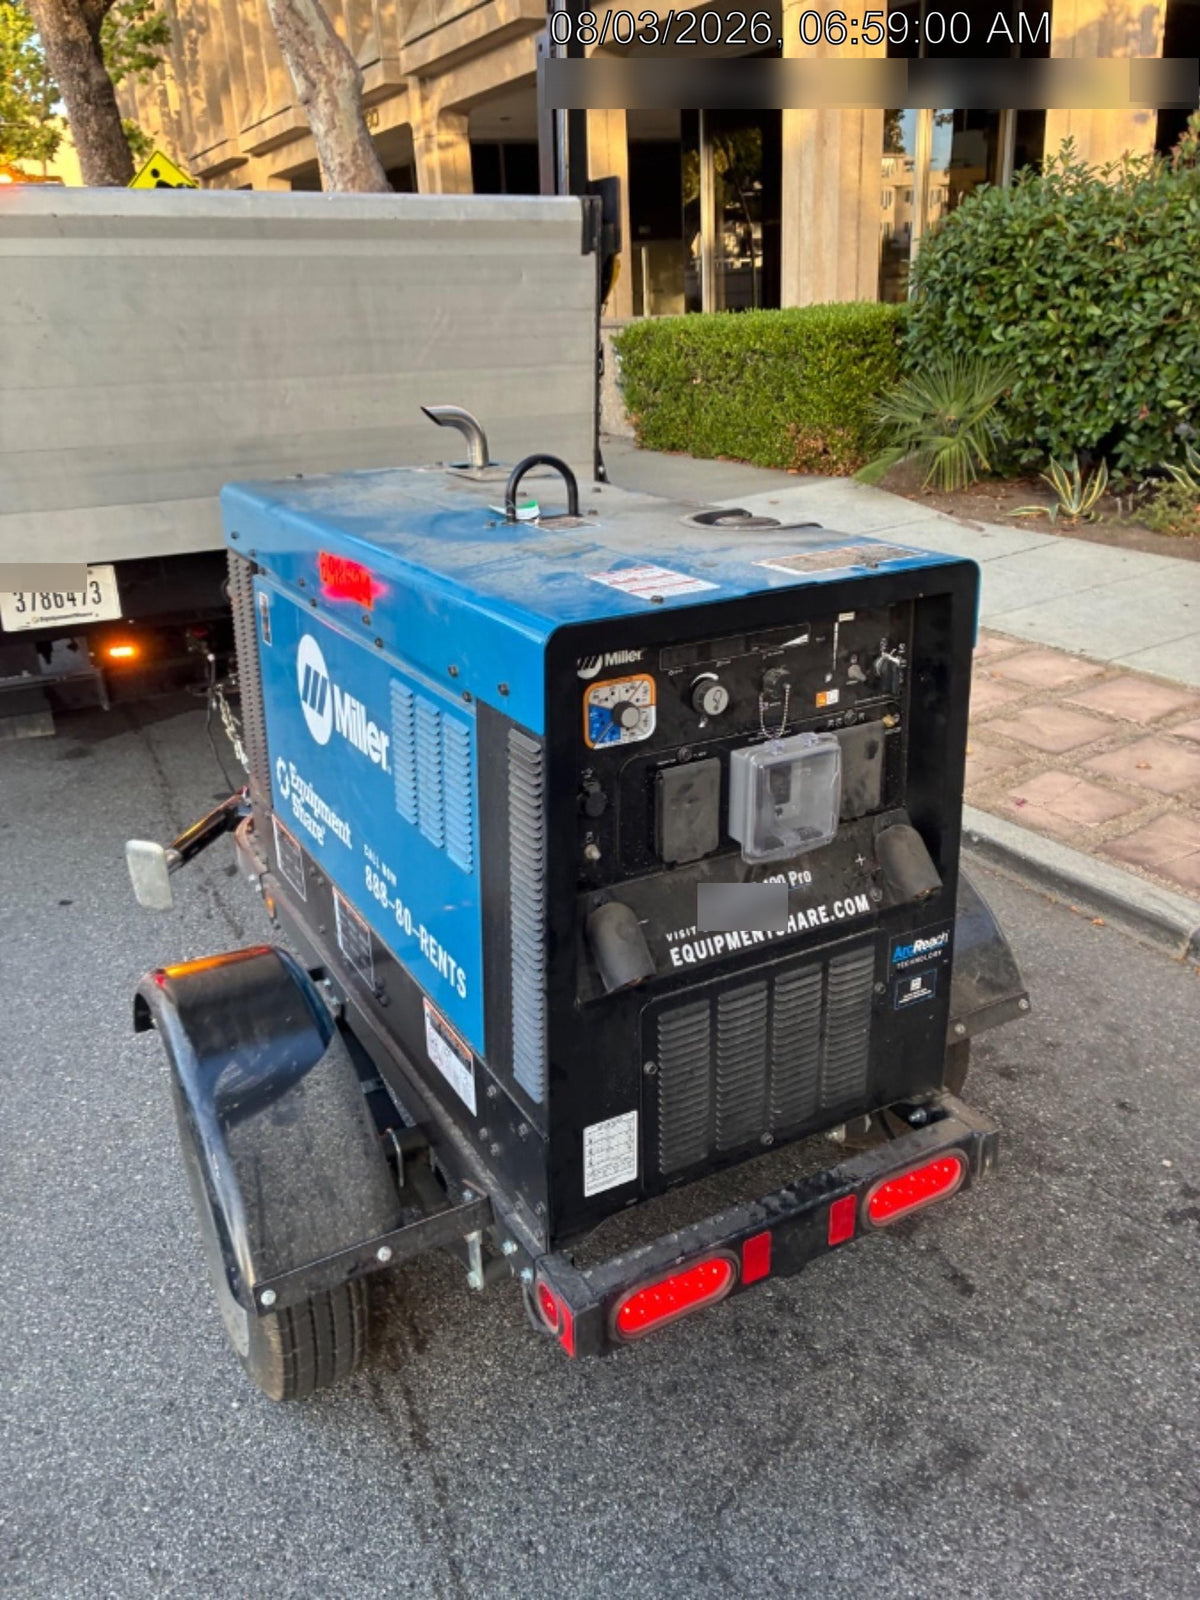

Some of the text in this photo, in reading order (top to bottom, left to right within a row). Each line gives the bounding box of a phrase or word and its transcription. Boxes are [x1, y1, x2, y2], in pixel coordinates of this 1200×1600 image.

[604, 649, 642, 667] Miller
[333, 685, 389, 771] Miller
[289, 761, 352, 850] Equipment
[788, 870, 812, 887] Pro
[364, 865, 467, 998] 888-80-RENTS
[665, 925, 697, 942] VISIT
